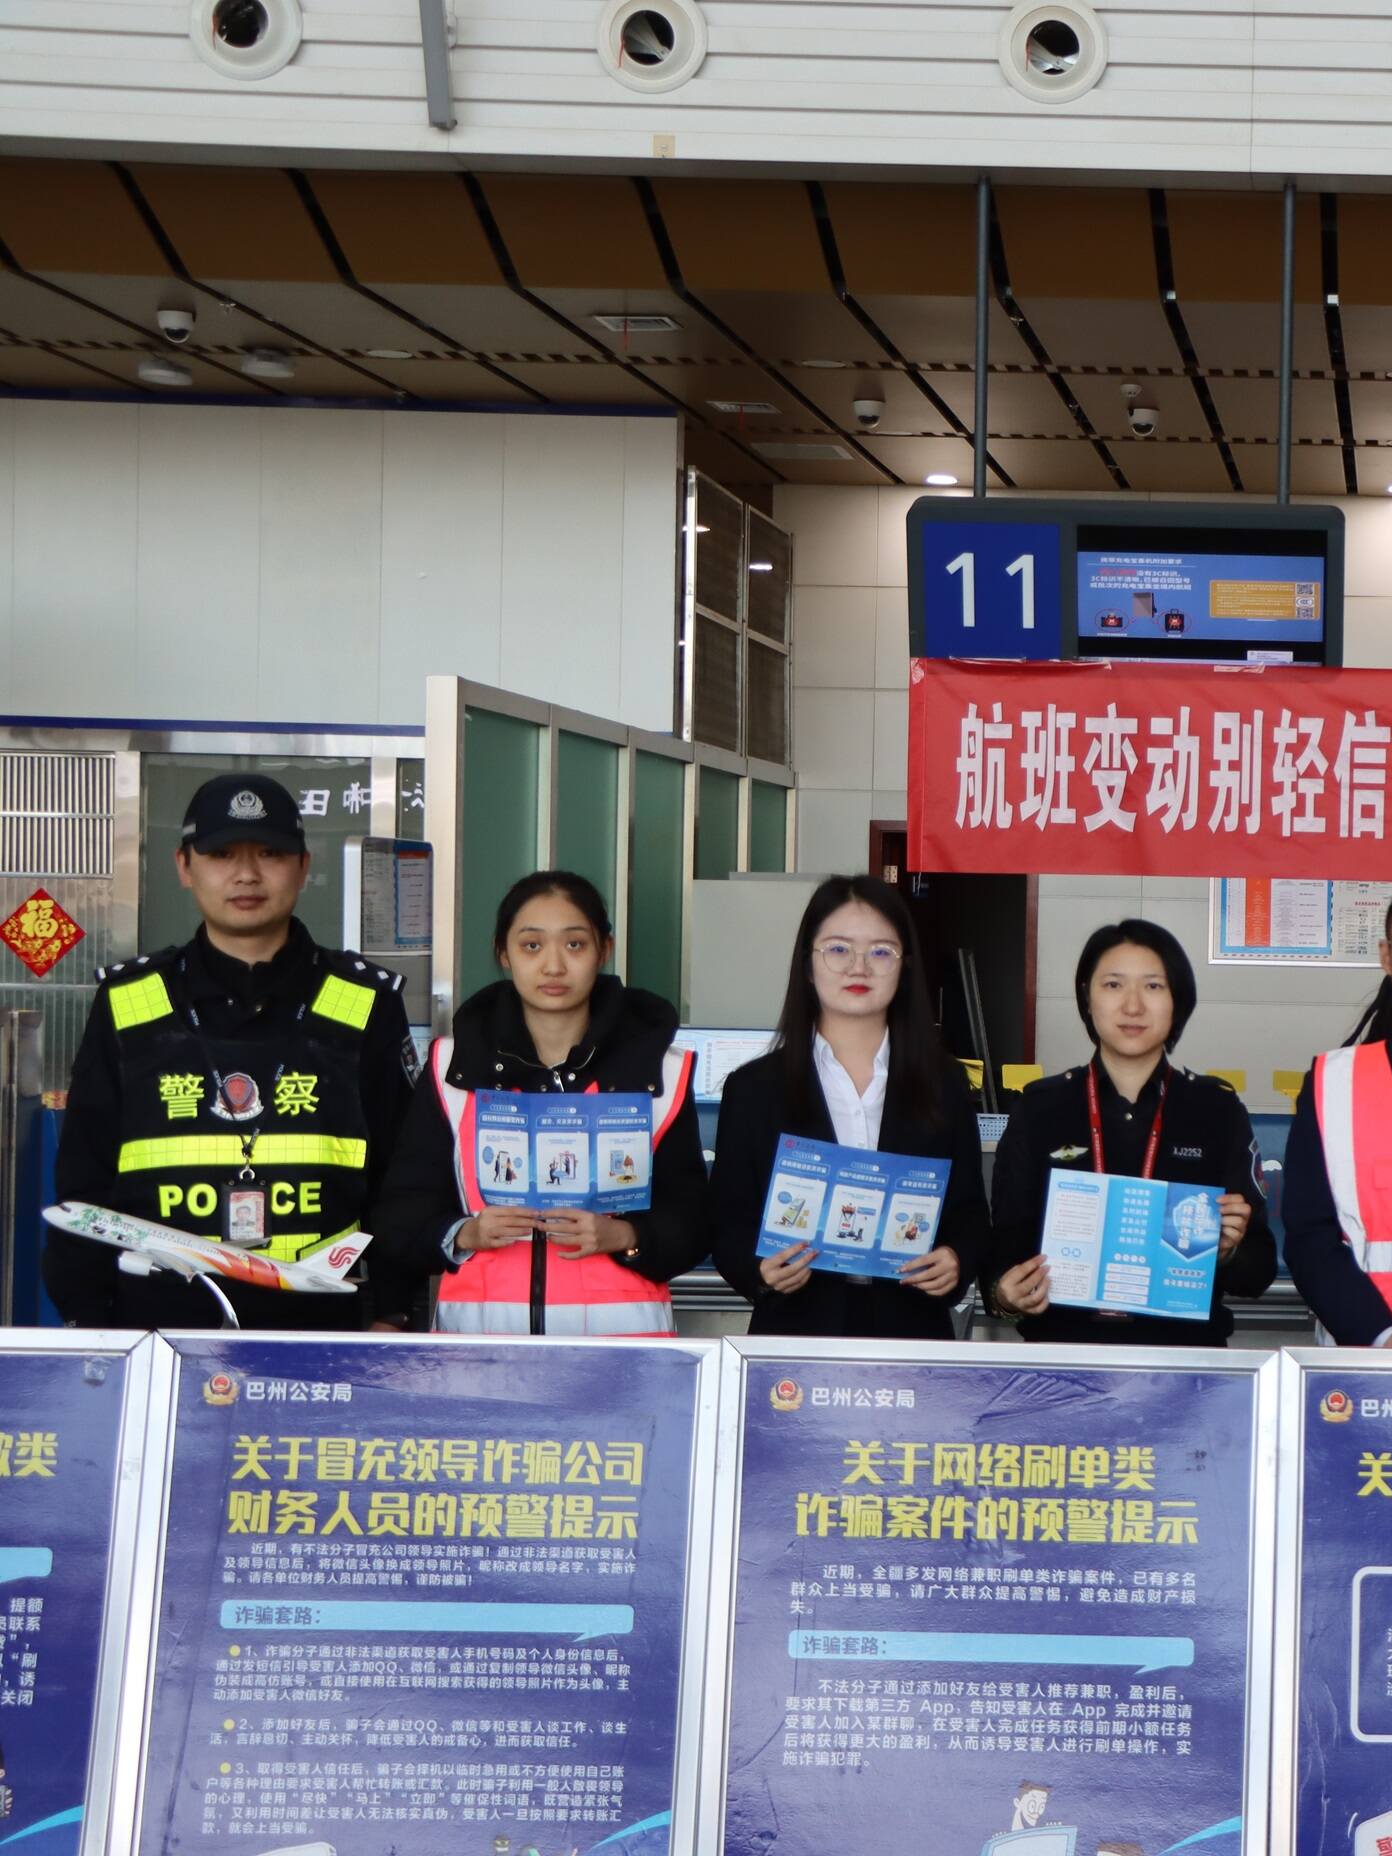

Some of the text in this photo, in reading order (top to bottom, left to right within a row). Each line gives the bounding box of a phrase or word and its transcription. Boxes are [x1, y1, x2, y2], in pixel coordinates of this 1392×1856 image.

[945, 552, 1036, 630] 11
[955, 702, 1391, 840] 航班变动别轻信
[20, 900, 58, 938] 福
[159, 1071, 321, 1120] 警 察
[158, 1181, 322, 1218] POCE
[246, 1381, 353, 1404] 巴州公安局
[811, 1387, 915, 1409] 巴州公安局
[231, 1435, 643, 1485] 关于冒充领导诈骗公司
[842, 1439, 1156, 1490] 关于网络刷单类
[228, 1491, 638, 1539] 财务人员的预警提示
[795, 1493, 1198, 1545] 诈骗案件的预警提示
[235, 1606, 321, 1625] 诈骗套路：
[790, 1600, 815, 1615] 失。
[803, 1635, 887, 1656] 诈骗套路：
